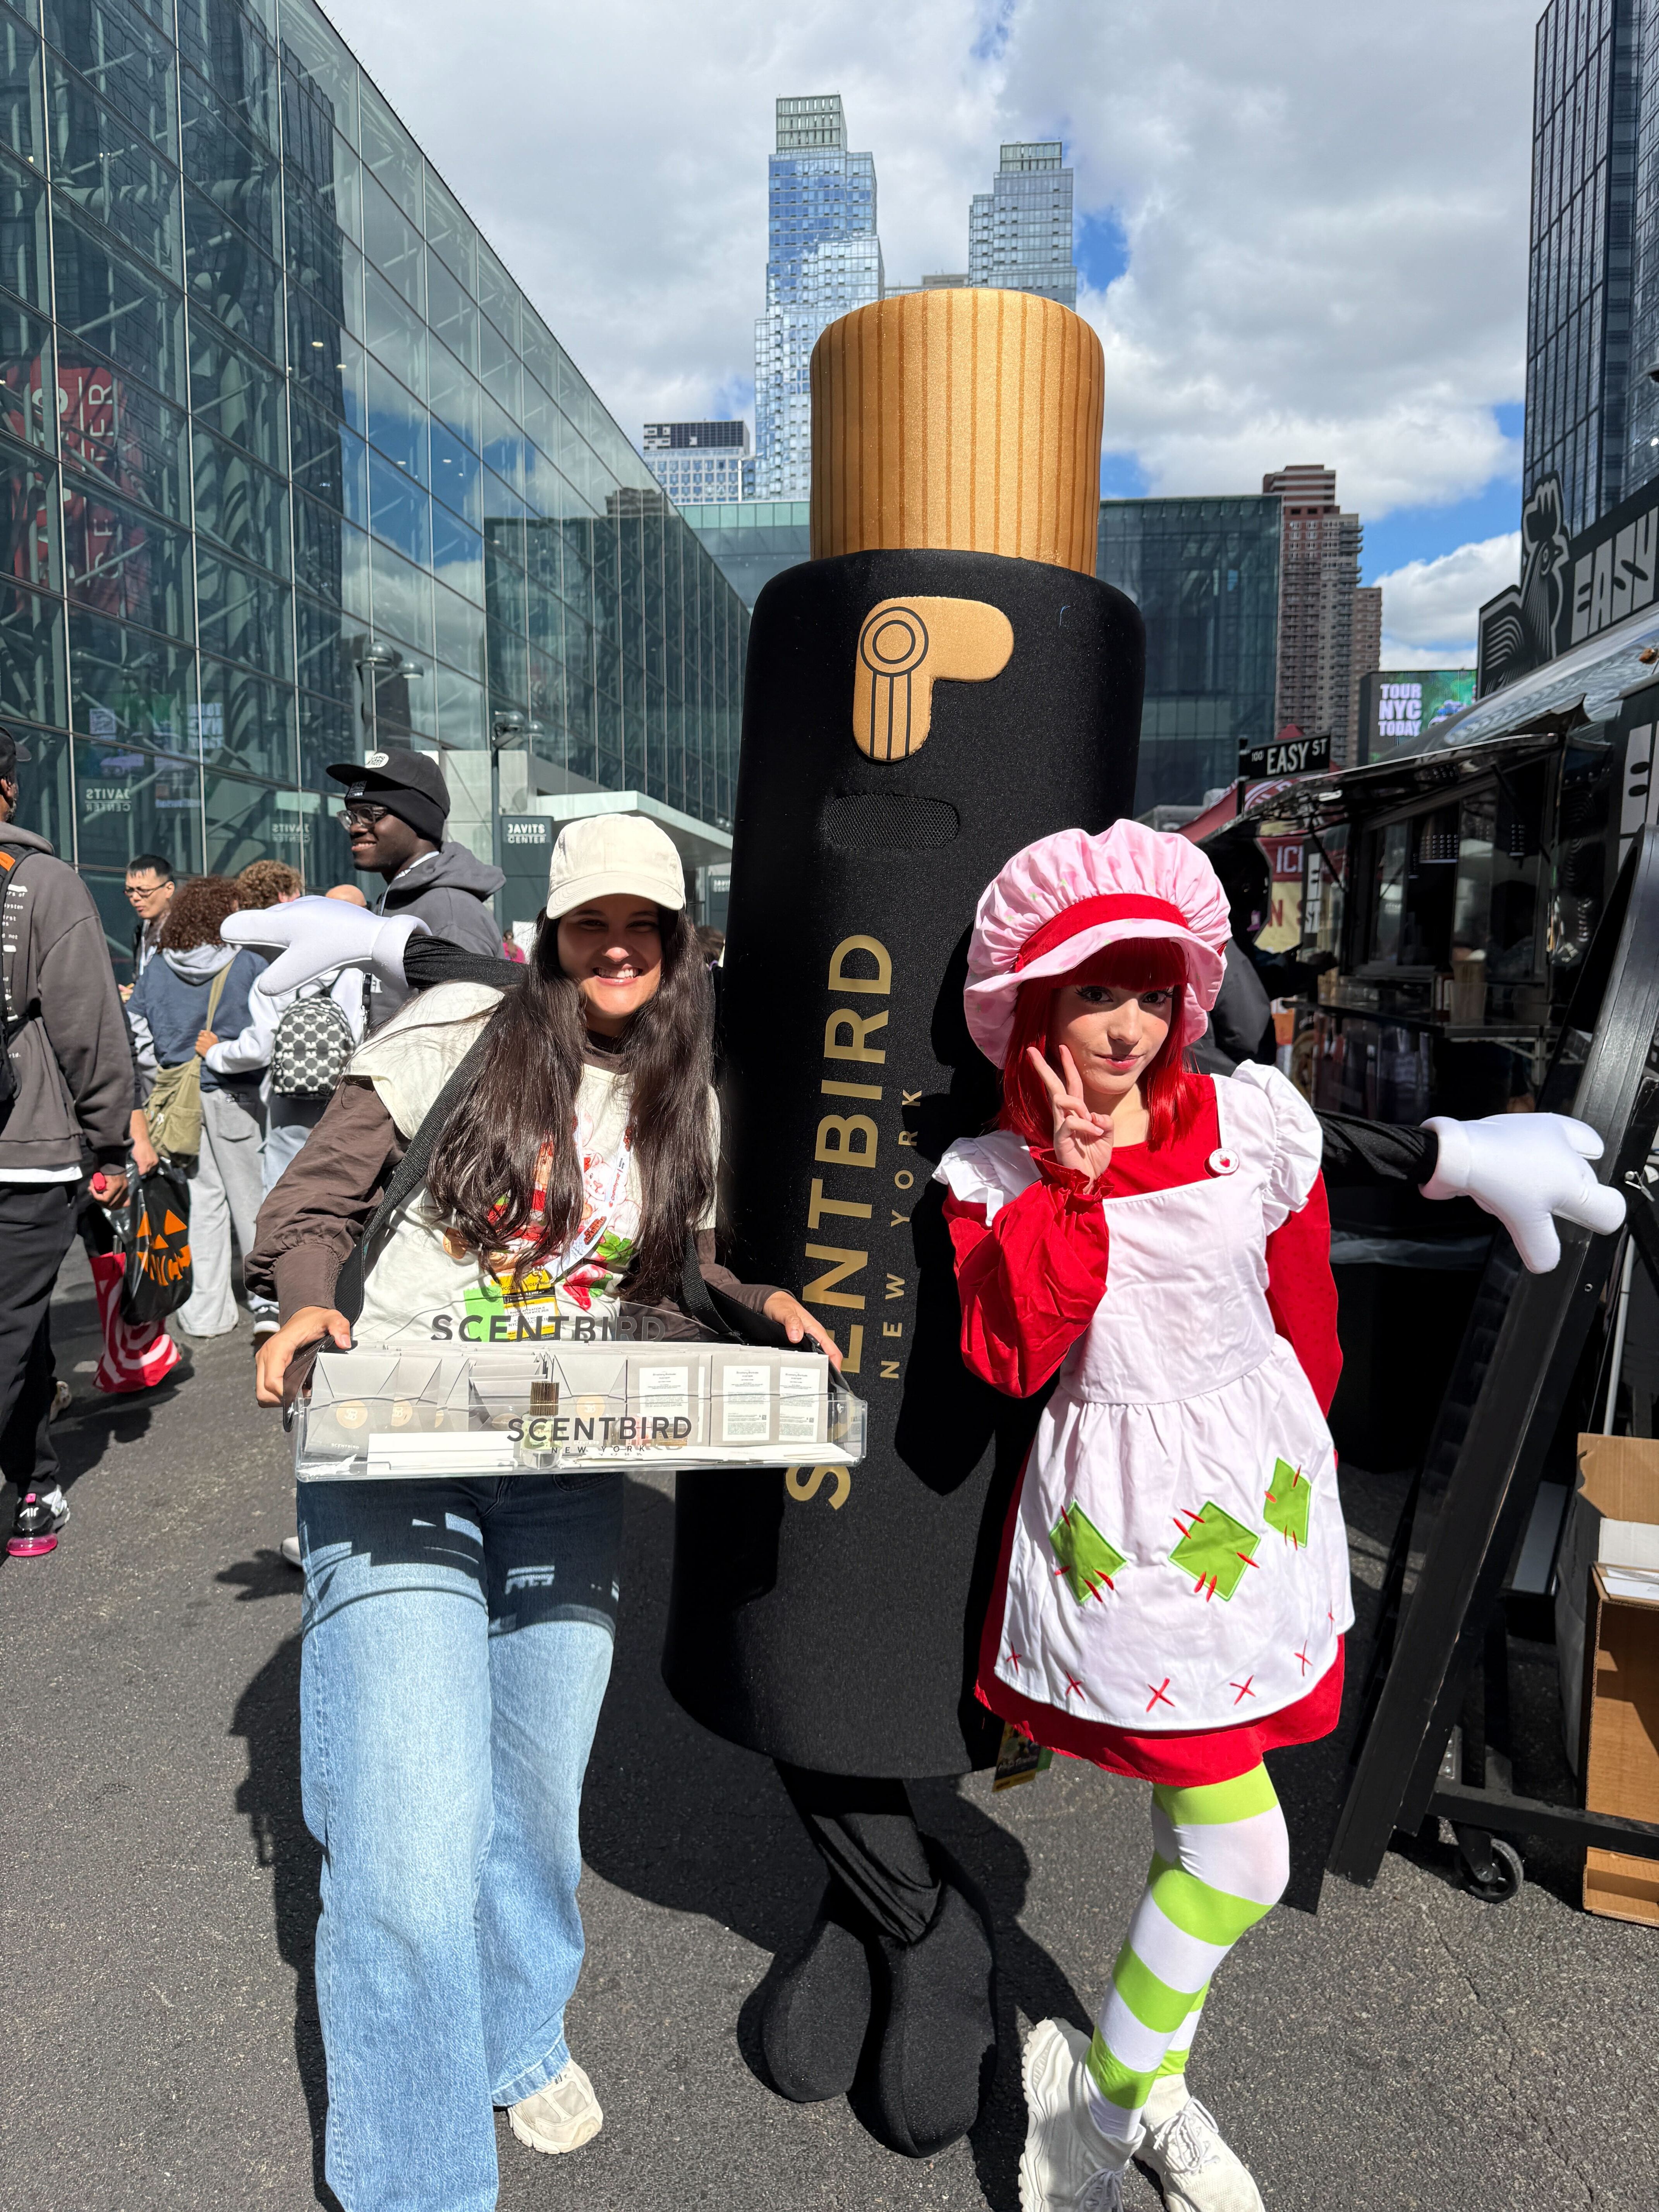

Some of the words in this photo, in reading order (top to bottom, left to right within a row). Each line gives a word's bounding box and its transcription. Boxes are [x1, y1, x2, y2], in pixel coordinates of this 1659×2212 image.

[1571, 506, 1658, 645] EASY
[1380, 683, 1422, 699] TOUR
[1379, 699, 1422, 720] NYC
[1378, 720, 1422, 737] TODAY
[1252, 750, 1264, 762] 100
[1267, 741, 1310, 775] EASY
[1312, 738, 1328, 756] ST
[508, 824, 545, 833] JAVITS
[890, 1089, 922, 1227] YORK
[785, 934, 892, 1510] SENTBIRD
[431, 1314, 665, 1342] SCENTBIRD
[880, 1273, 905, 1379] NEW
[507, 1416, 692, 1442] SCENTBIRD
[551, 1446, 586, 1454] NEW
